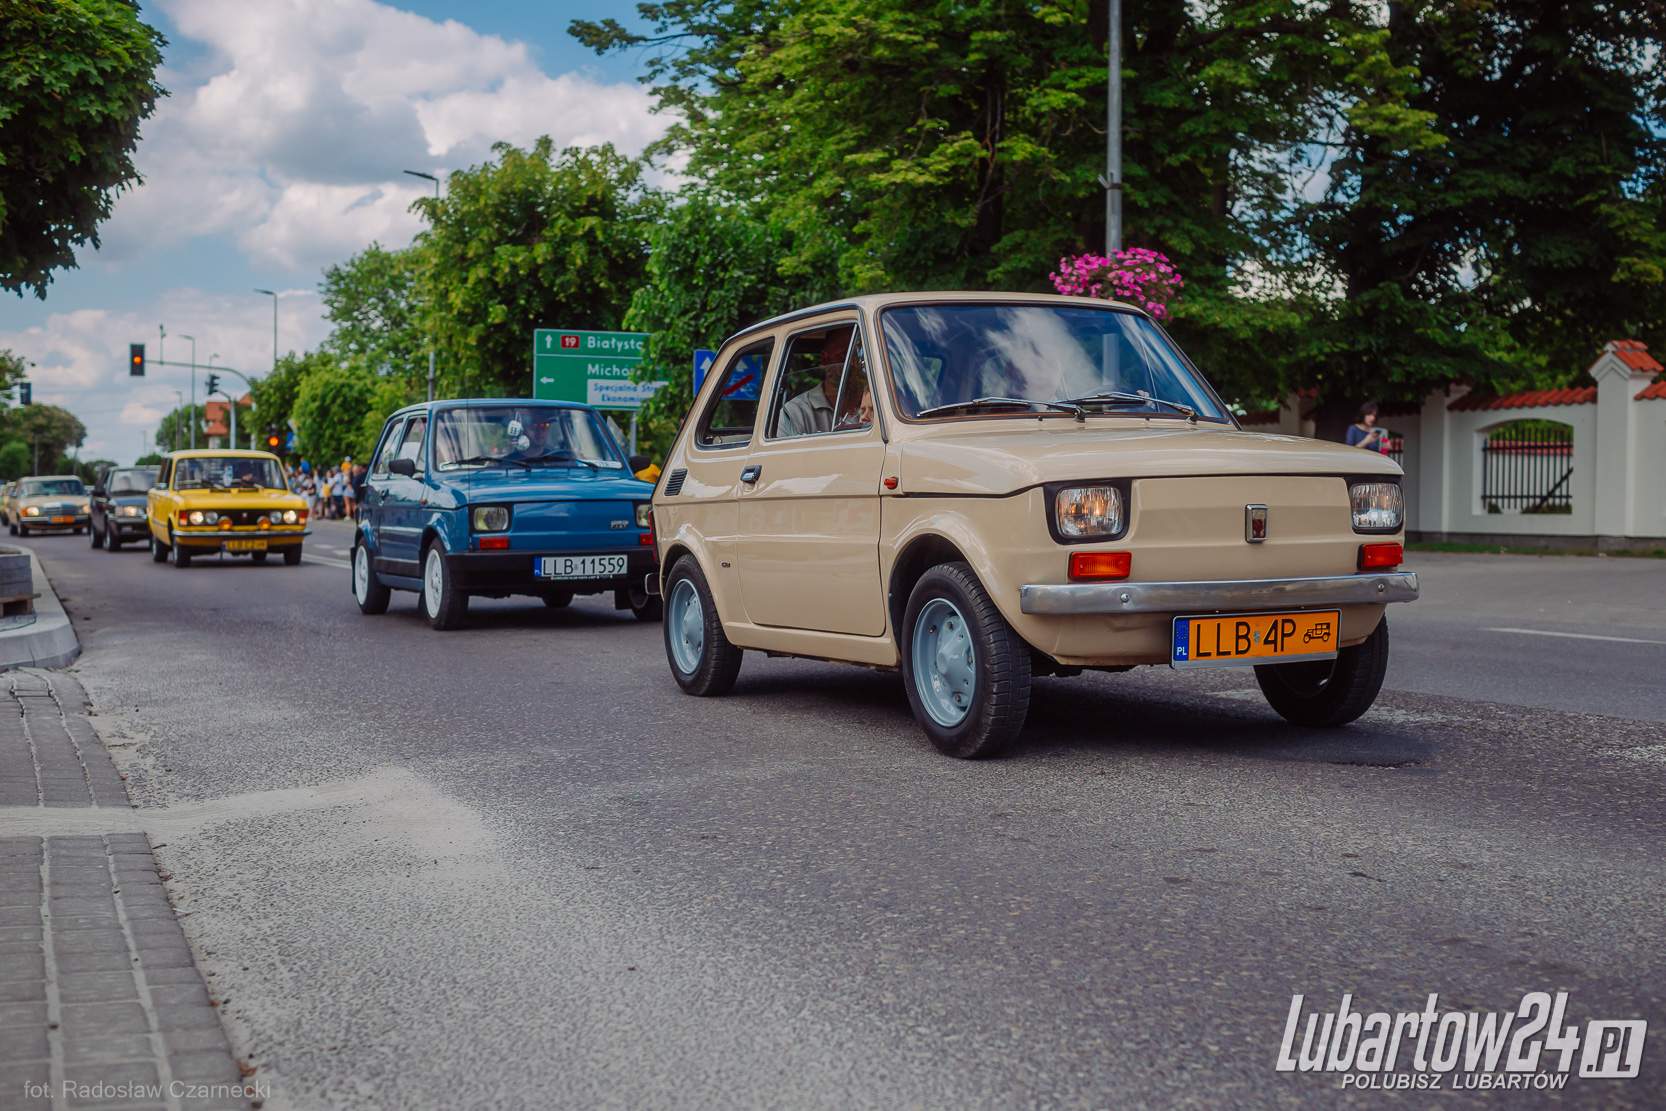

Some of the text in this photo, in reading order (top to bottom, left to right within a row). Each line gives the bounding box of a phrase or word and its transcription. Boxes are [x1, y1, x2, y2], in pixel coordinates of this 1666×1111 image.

[564, 336, 644, 352] 19 Białysto
[543, 557, 626, 576] LLB 11559
[1195, 618, 1297, 658] LLB 4P
[1176, 647, 1188, 656] PL
